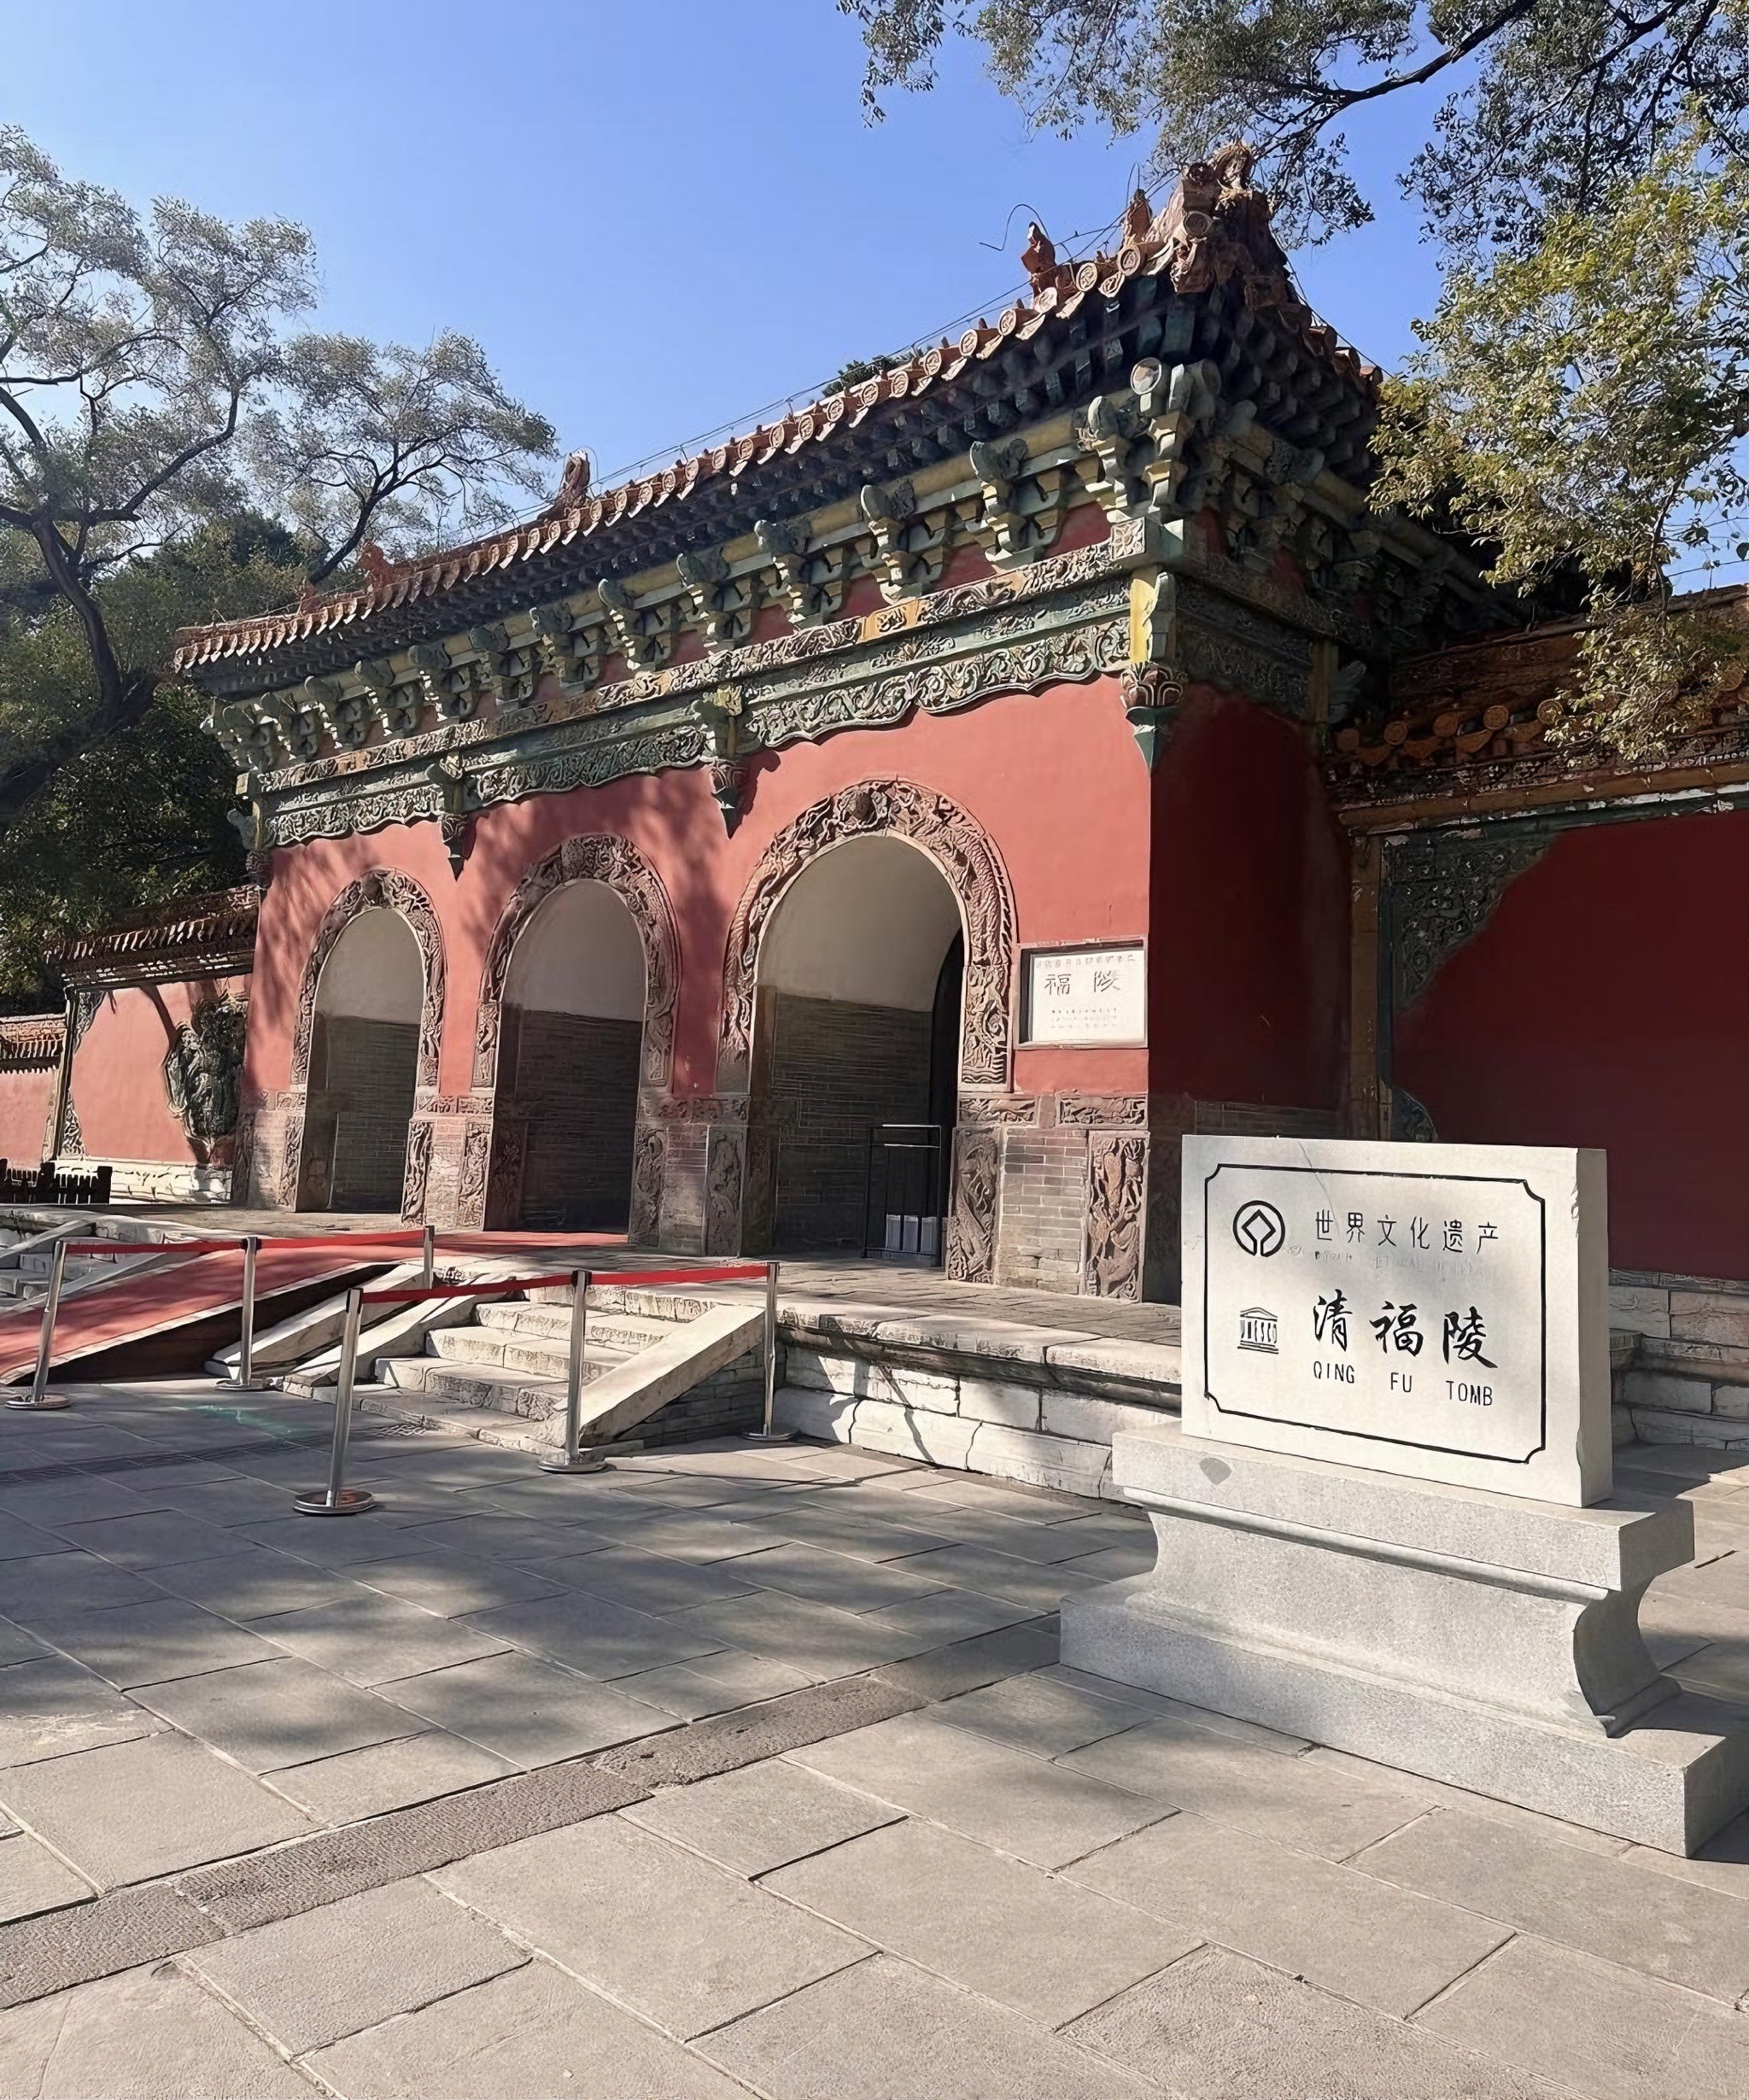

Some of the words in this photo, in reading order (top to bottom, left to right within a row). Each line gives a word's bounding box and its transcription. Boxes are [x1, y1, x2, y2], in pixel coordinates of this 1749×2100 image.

[1315, 1208, 1499, 1255] 世界文化遗产
[1313, 1288, 1499, 1368] 清福陵
[1313, 1360, 1355, 1384] QING
[1390, 1372, 1413, 1394] FU
[1446, 1380, 1494, 1407] TOMB
